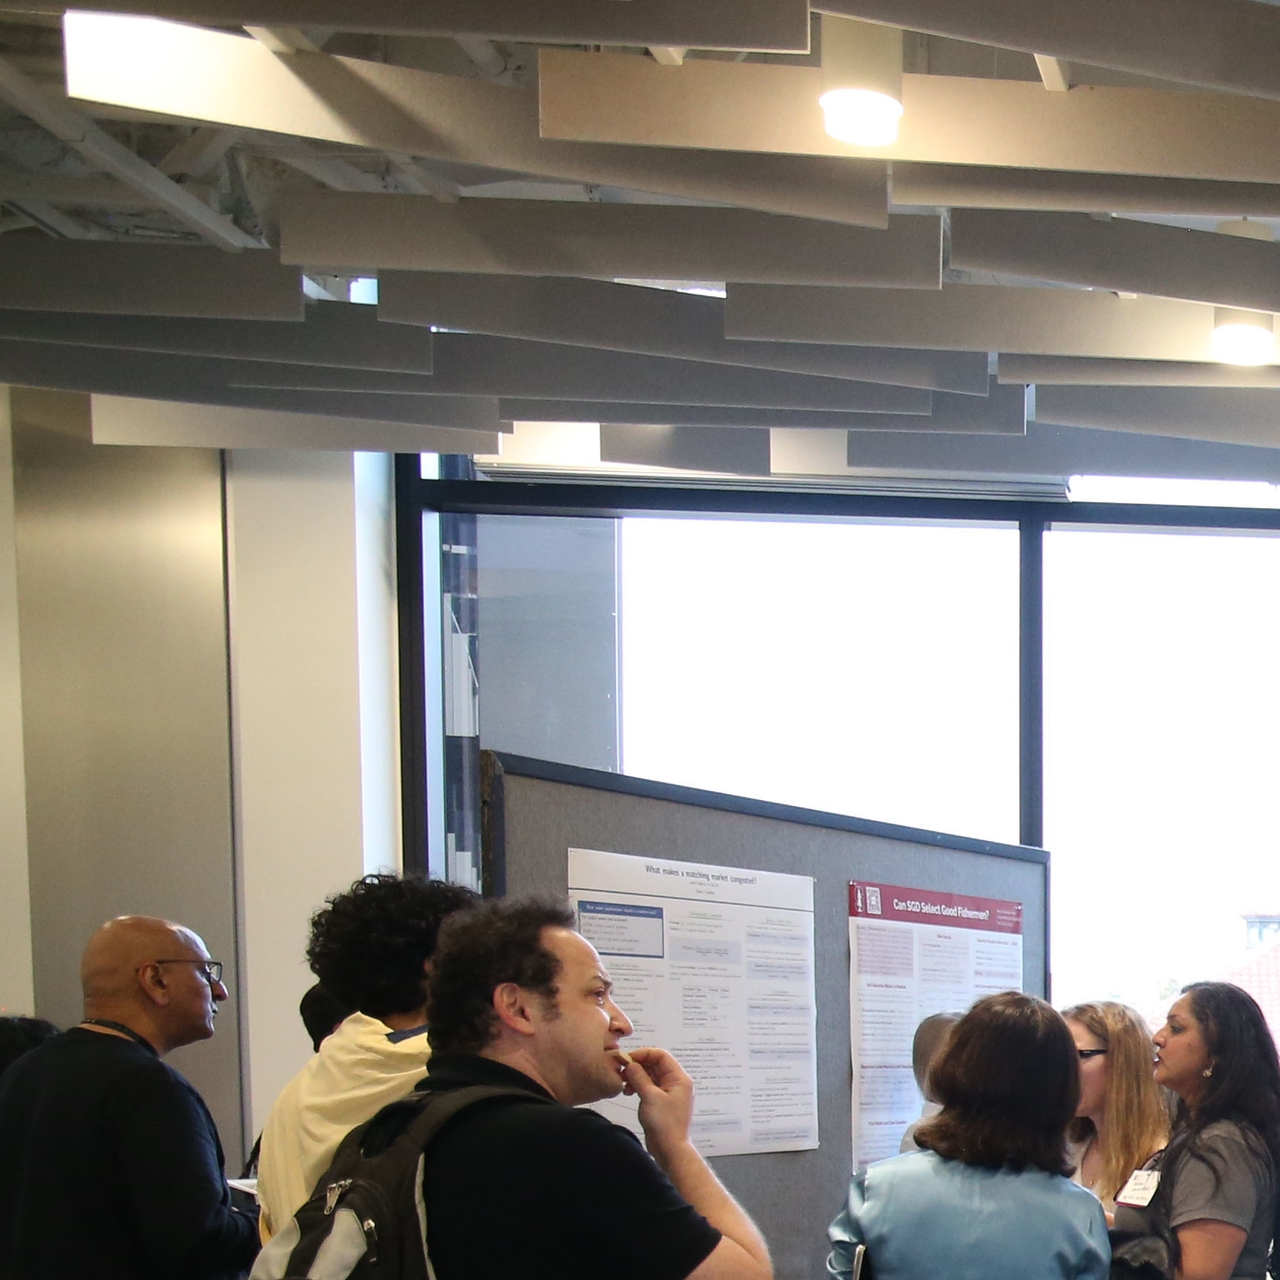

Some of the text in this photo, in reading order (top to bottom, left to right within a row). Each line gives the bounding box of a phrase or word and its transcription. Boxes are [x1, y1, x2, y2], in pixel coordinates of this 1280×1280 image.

[645, 864, 661, 874] What
[662, 867, 679, 877] makes
[685, 870, 710, 882] matching
[711, 872, 729, 882] market
[730, 875, 757, 886] congested?
[893, 899, 906, 911] Can
[907, 900, 921, 912] SGD
[921, 901, 941, 915] Select
[941, 904, 957, 917] Good
[958, 906, 990, 920] Fishermen?
